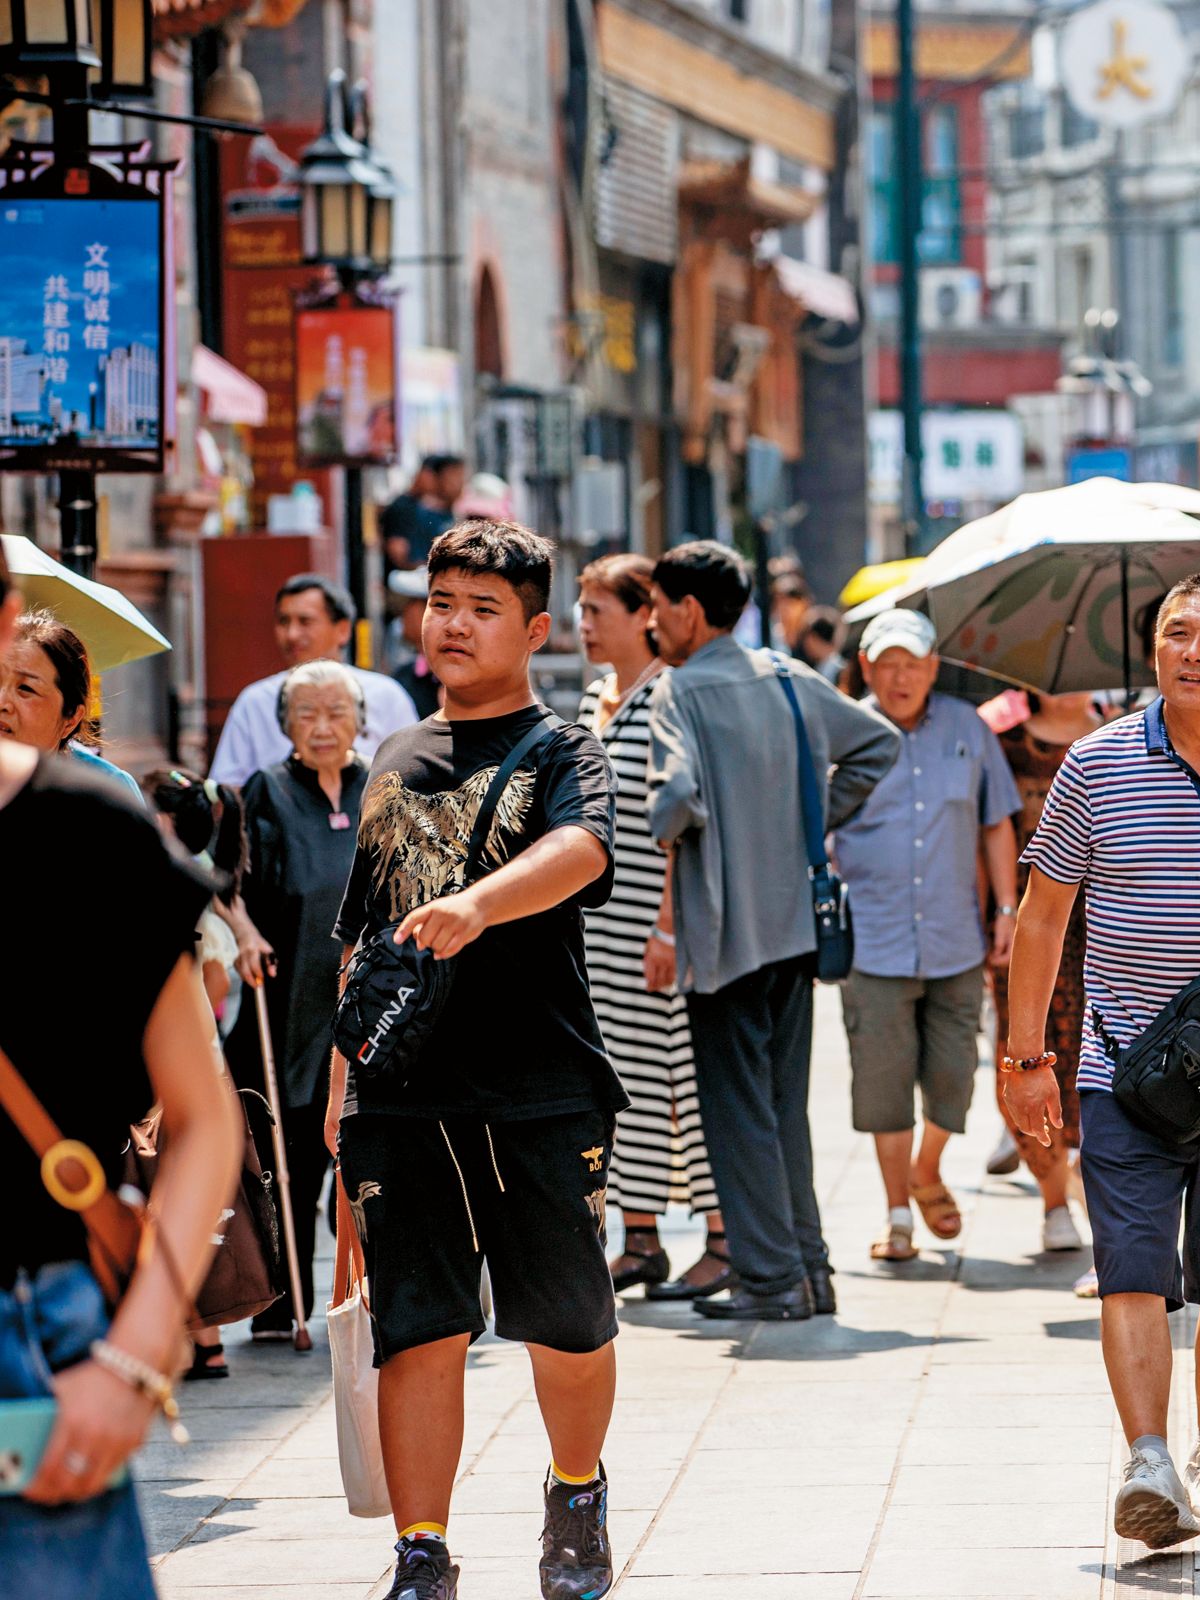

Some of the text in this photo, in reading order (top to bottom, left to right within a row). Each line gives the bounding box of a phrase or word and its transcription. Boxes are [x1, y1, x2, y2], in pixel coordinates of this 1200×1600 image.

[1098, 20, 1152, 99] 大
[43, 274, 70, 382] 共建和谐
[84, 242, 110, 349] 文明诚信
[357, 986, 416, 1065] CHINA
